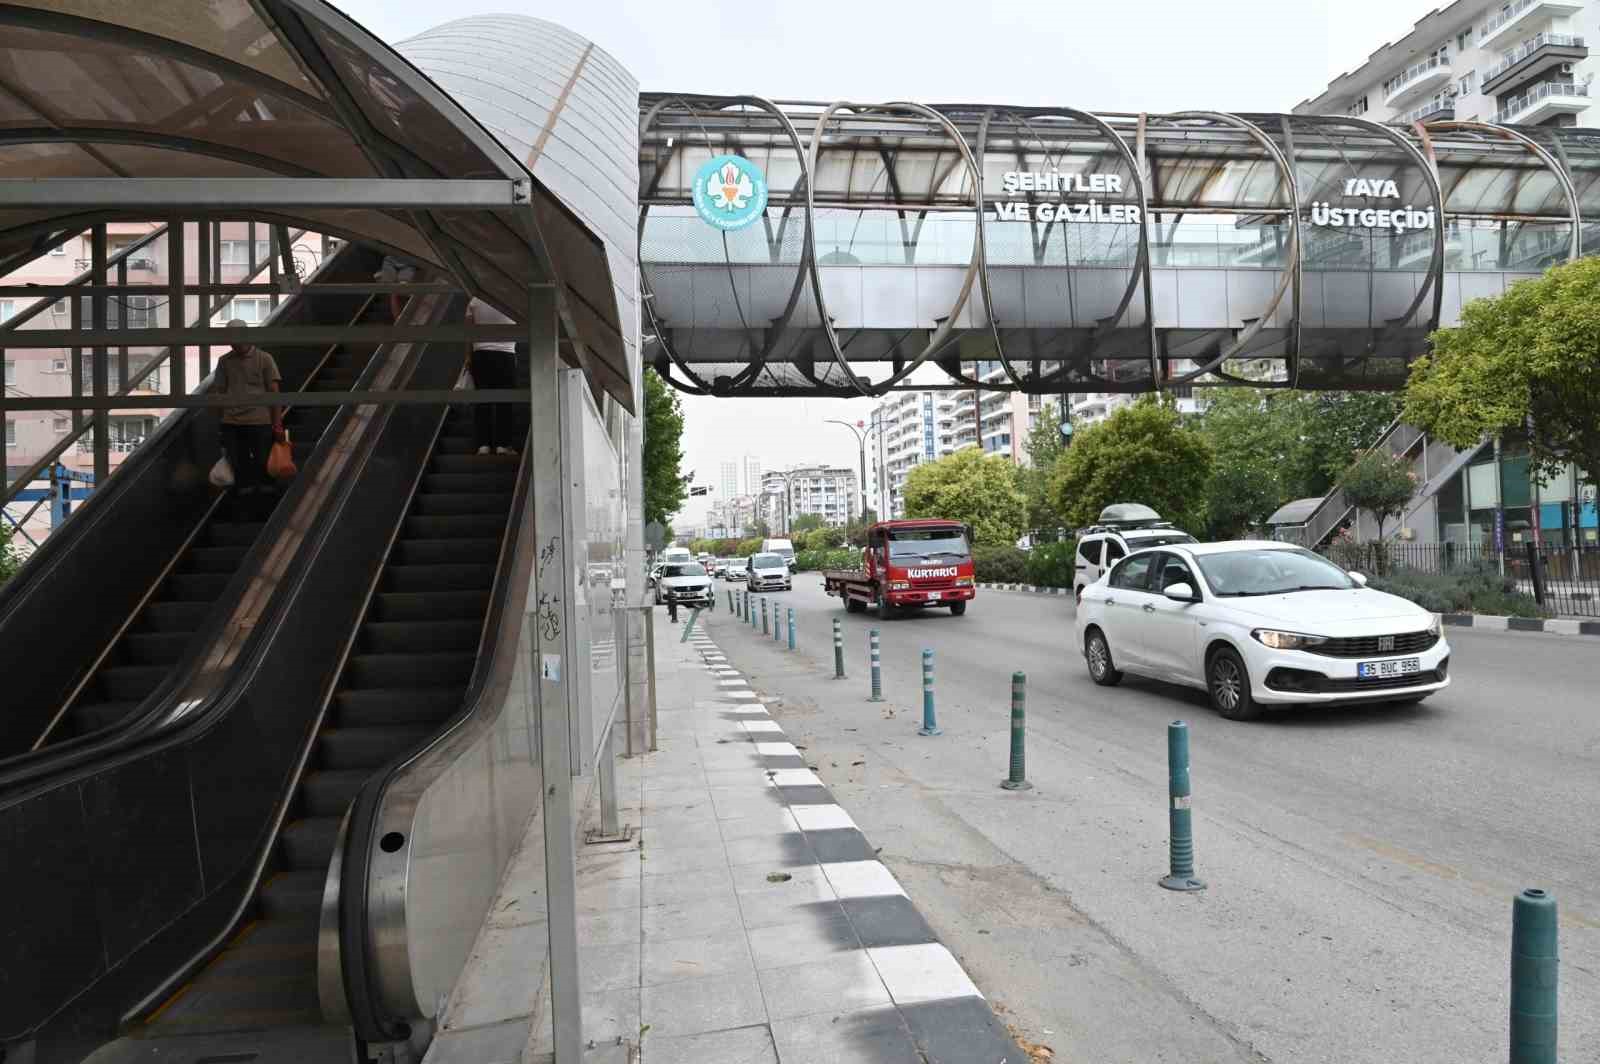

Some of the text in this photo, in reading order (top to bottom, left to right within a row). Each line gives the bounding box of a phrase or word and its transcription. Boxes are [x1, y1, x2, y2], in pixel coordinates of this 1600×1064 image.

[1002, 167, 1122, 196] ŞEHİTLER
[1343, 178, 1400, 198] YAYA
[995, 199, 1141, 223] VE GAZİLER
[1311, 201, 1435, 234] ÜSTGEÇİDİ
[907, 566, 958, 579] KURTARICI
[1363, 663, 1376, 675] 35
